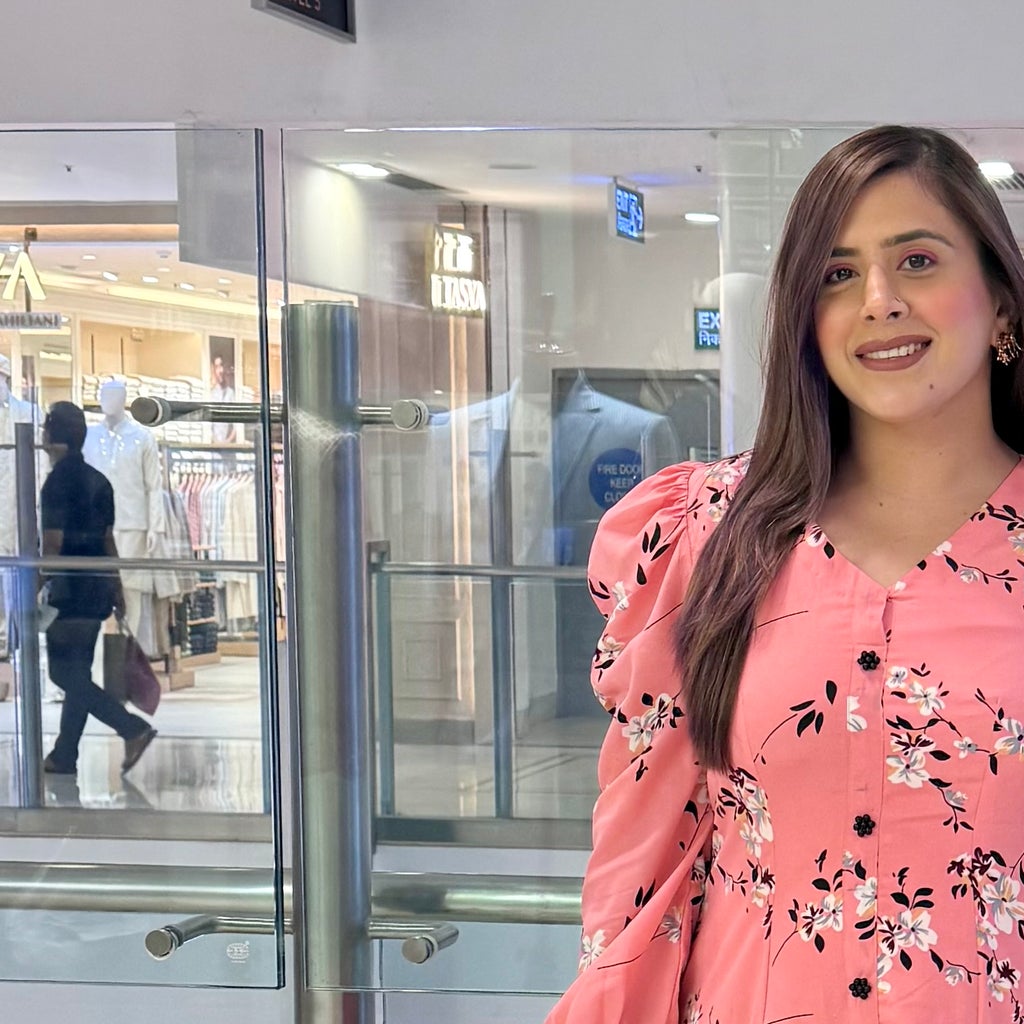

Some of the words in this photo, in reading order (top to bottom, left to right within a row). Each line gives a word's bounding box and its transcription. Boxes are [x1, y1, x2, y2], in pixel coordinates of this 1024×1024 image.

[0, 251, 46, 300] A
[698, 311, 720, 329] EX
[597, 463, 618, 475] FIRE
[619, 463, 641, 475] DOO
